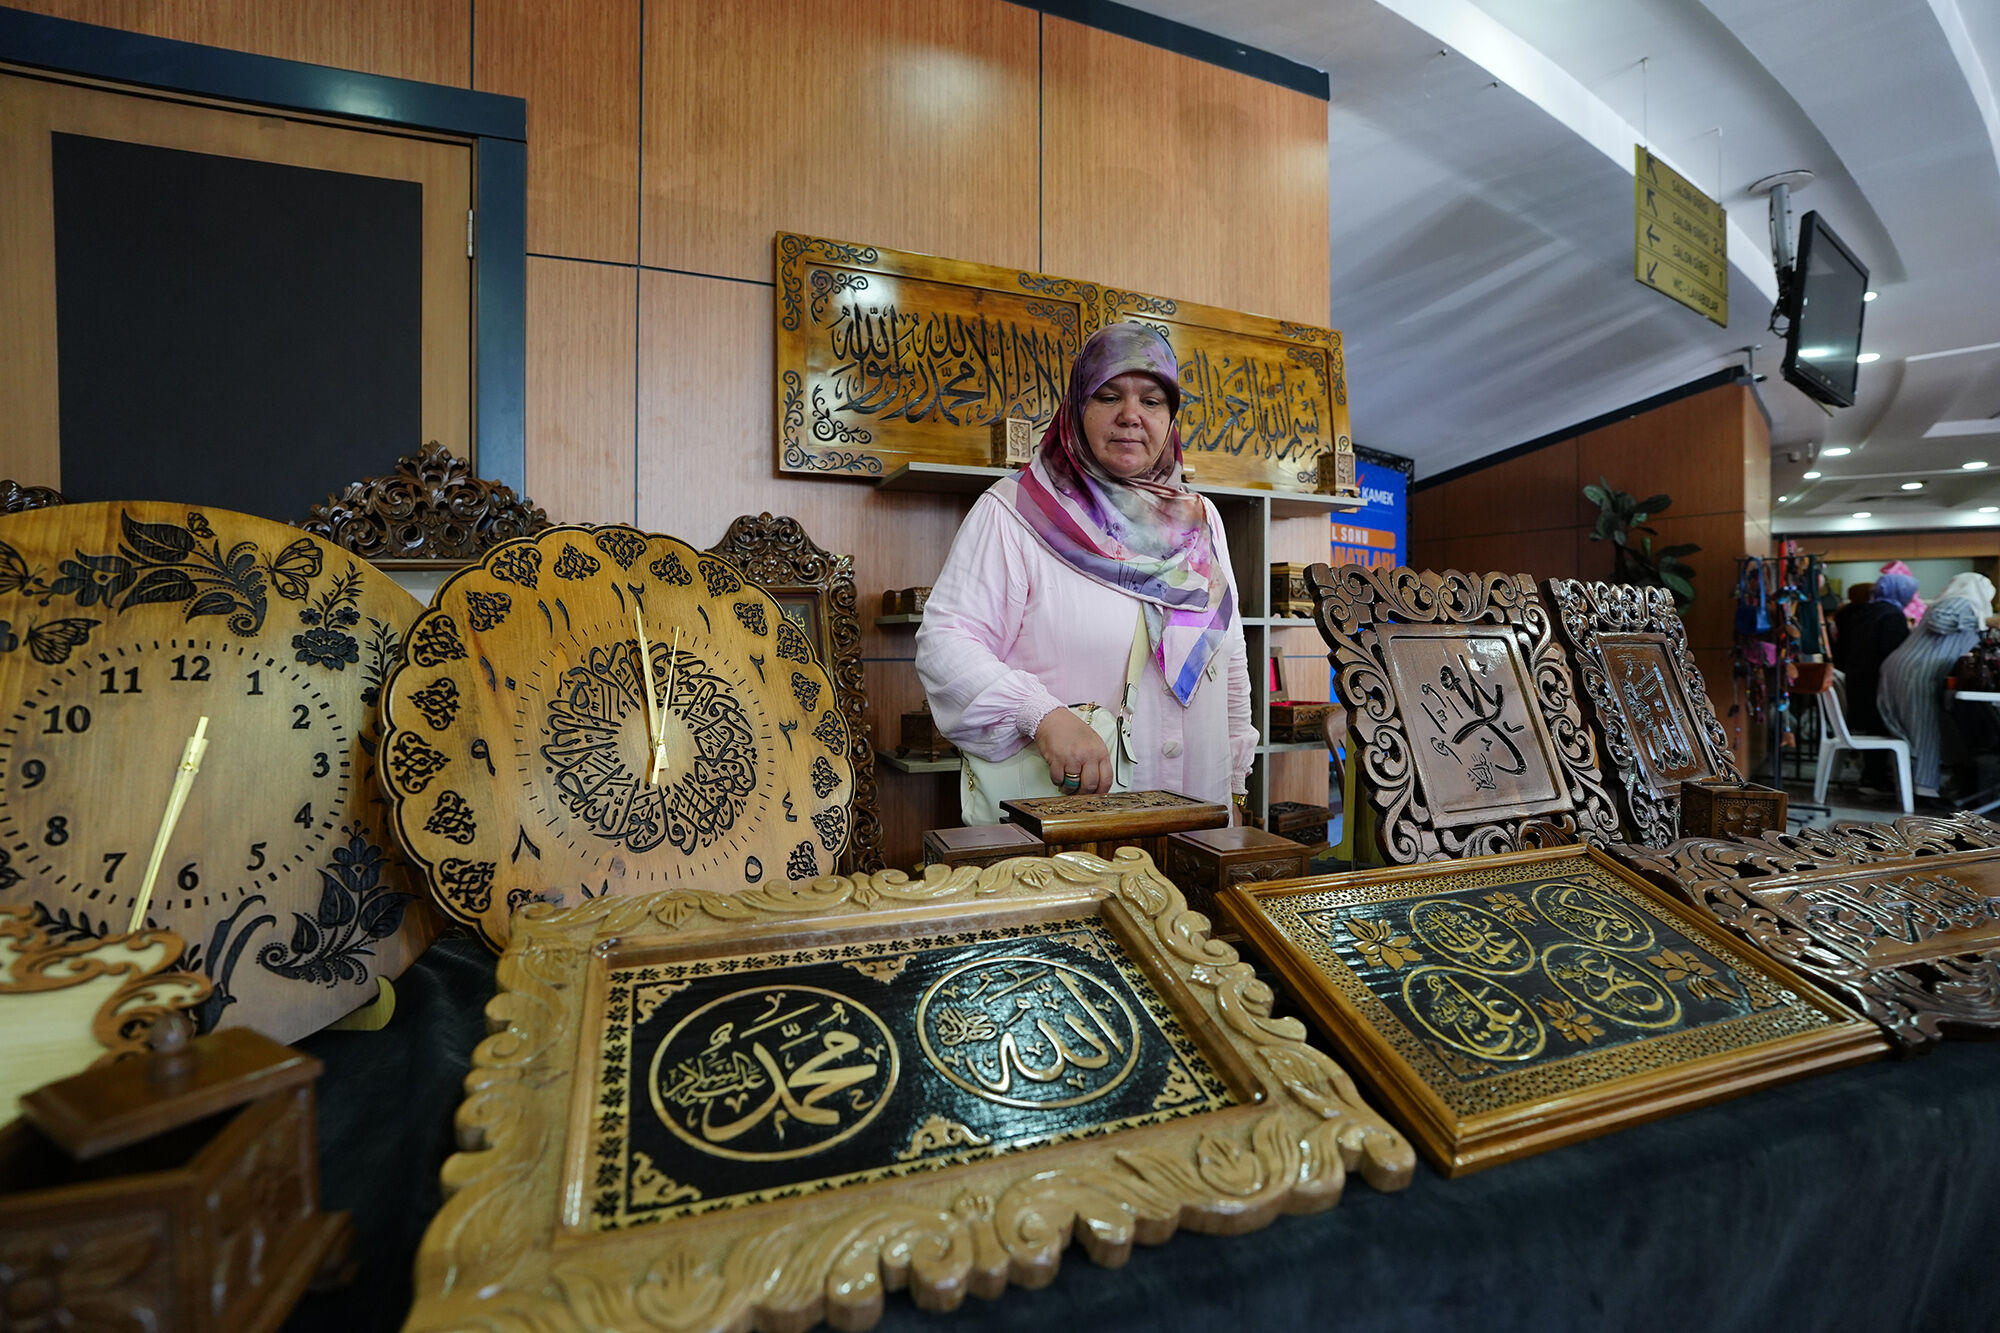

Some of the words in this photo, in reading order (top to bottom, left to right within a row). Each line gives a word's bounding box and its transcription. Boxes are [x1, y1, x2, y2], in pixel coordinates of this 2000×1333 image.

[1341, 527, 1369, 545] SONU
[99, 667, 143, 695] 11
[170, 655, 212, 682] 12
[246, 670, 264, 696] 1
[42, 704, 92, 735] 10
[292, 704, 312, 730] 2
[21, 759, 46, 789] 9
[312, 752, 331, 779] 3
[293, 801, 314, 830] 4
[44, 815, 69, 847] 8
[103, 851, 128, 884] 7
[247, 841, 268, 872] 5
[177, 862, 200, 892] 6
[966, 967, 1125, 1094] الله
[701, 1027, 879, 1143] محمد
